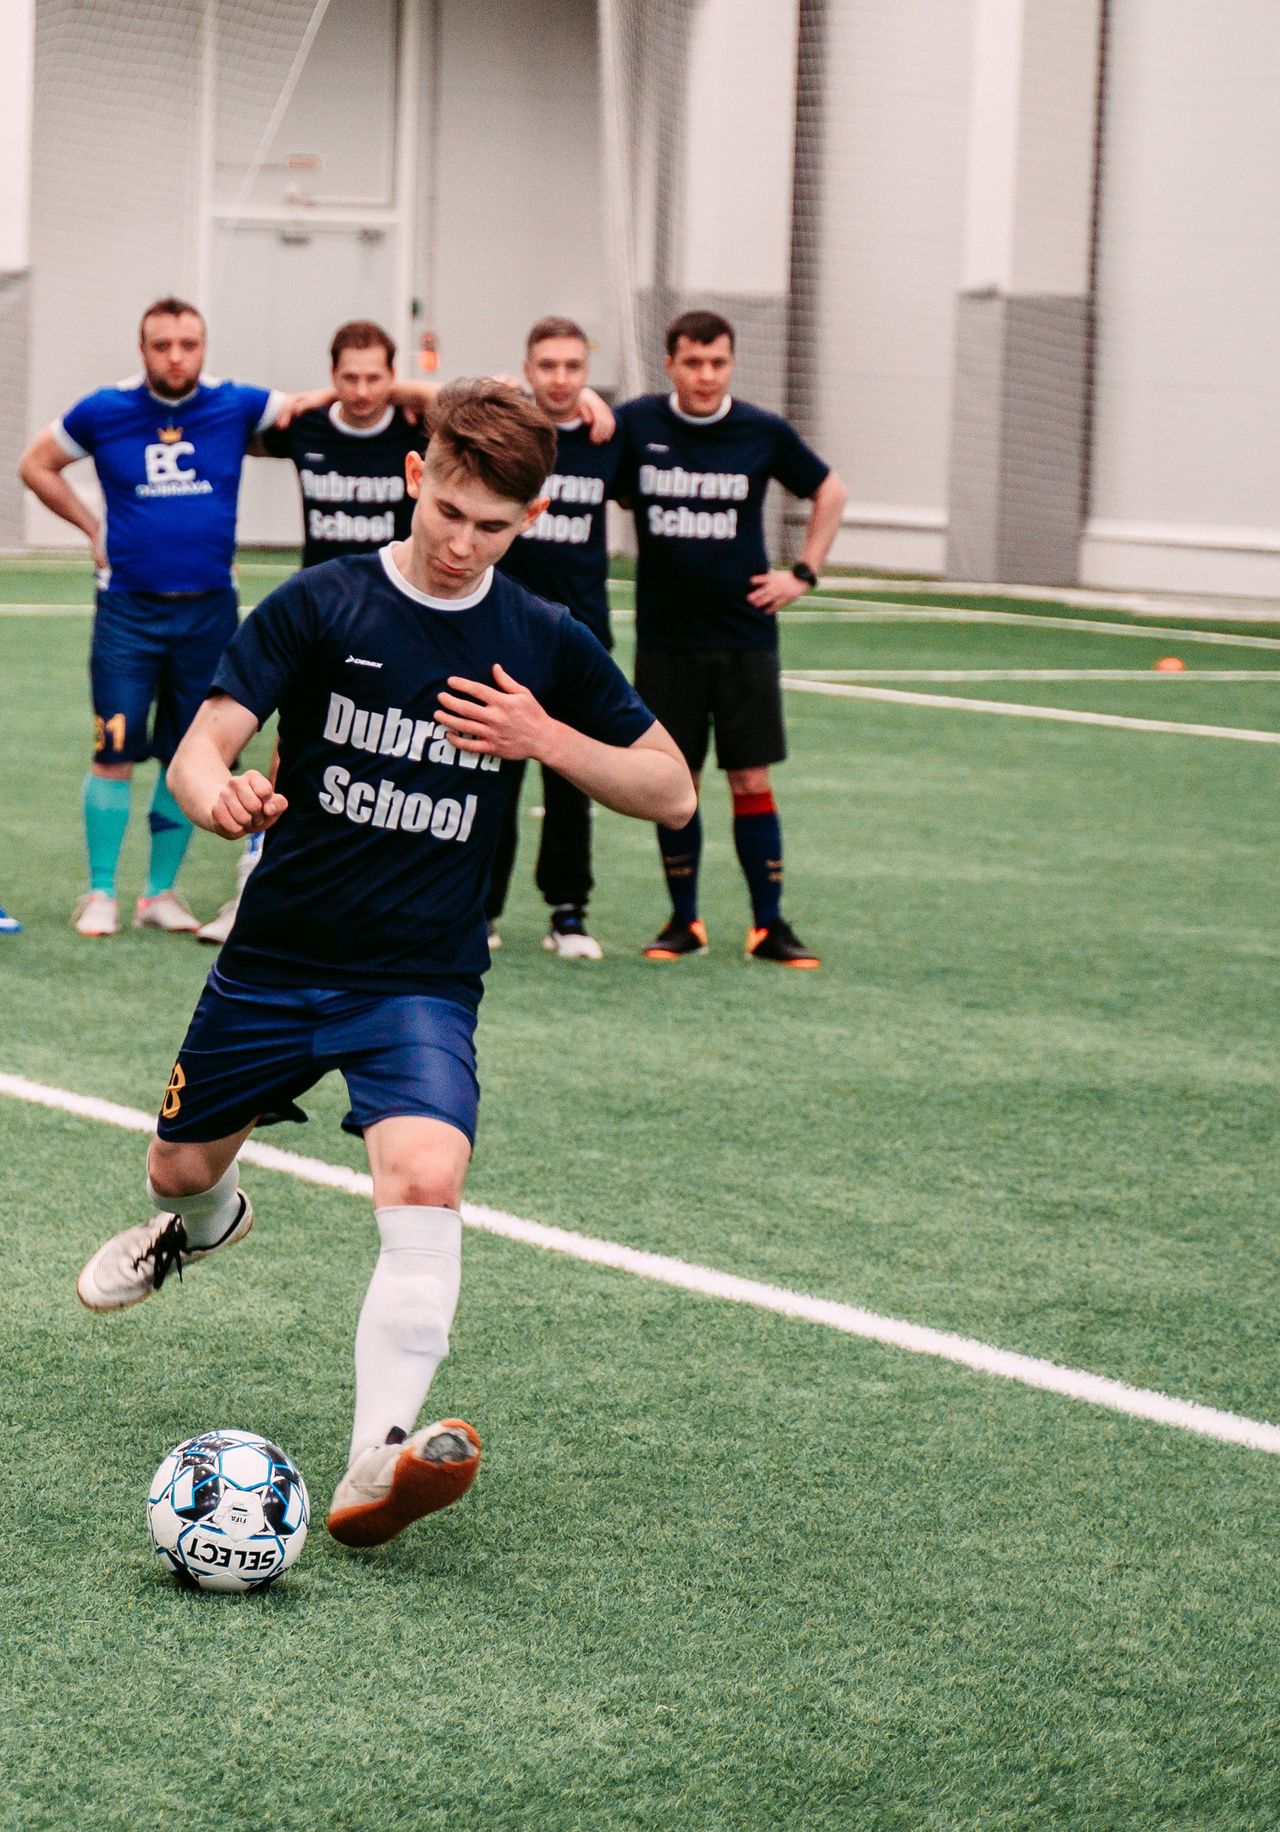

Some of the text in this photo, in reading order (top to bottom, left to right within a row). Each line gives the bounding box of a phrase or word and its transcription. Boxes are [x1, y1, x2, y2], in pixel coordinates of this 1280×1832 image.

[299, 468, 405, 503] Dubrava
[639, 464, 750, 501] Dubrava
[308, 508, 396, 542] School
[647, 504, 738, 540] School
[318, 764, 478, 843] School
[231, 1515, 247, 1524] FIFA
[187, 1538, 276, 1571] SELECT
